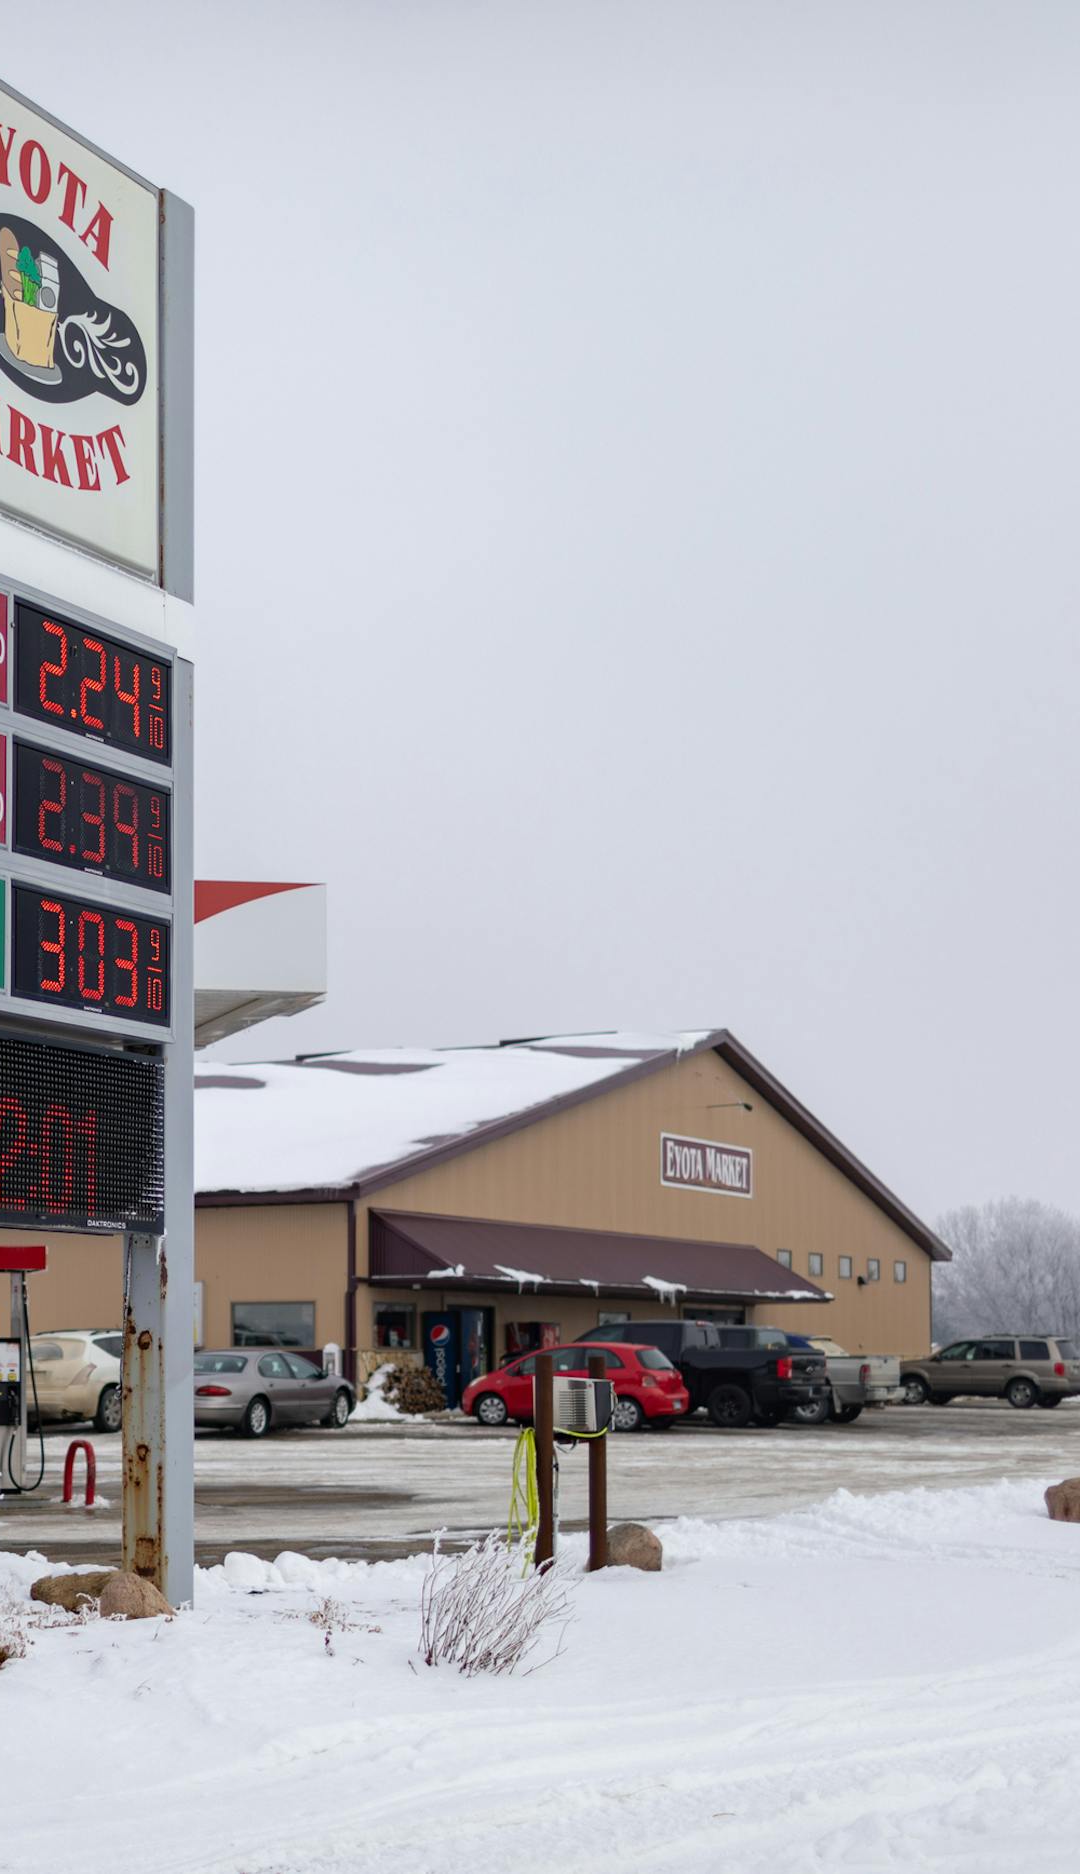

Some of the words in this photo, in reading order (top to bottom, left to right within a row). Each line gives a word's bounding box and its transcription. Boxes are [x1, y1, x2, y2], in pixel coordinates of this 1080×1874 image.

[39, 620, 140, 737] 2.24
[38, 758, 140, 869] 2.39
[665, 1140, 703, 1180] EYOTA
[705, 1147, 748, 1189] MARKET
[87, 1219, 126, 1230] DAKTRONICS
[434, 1347, 448, 1387] pepsi
